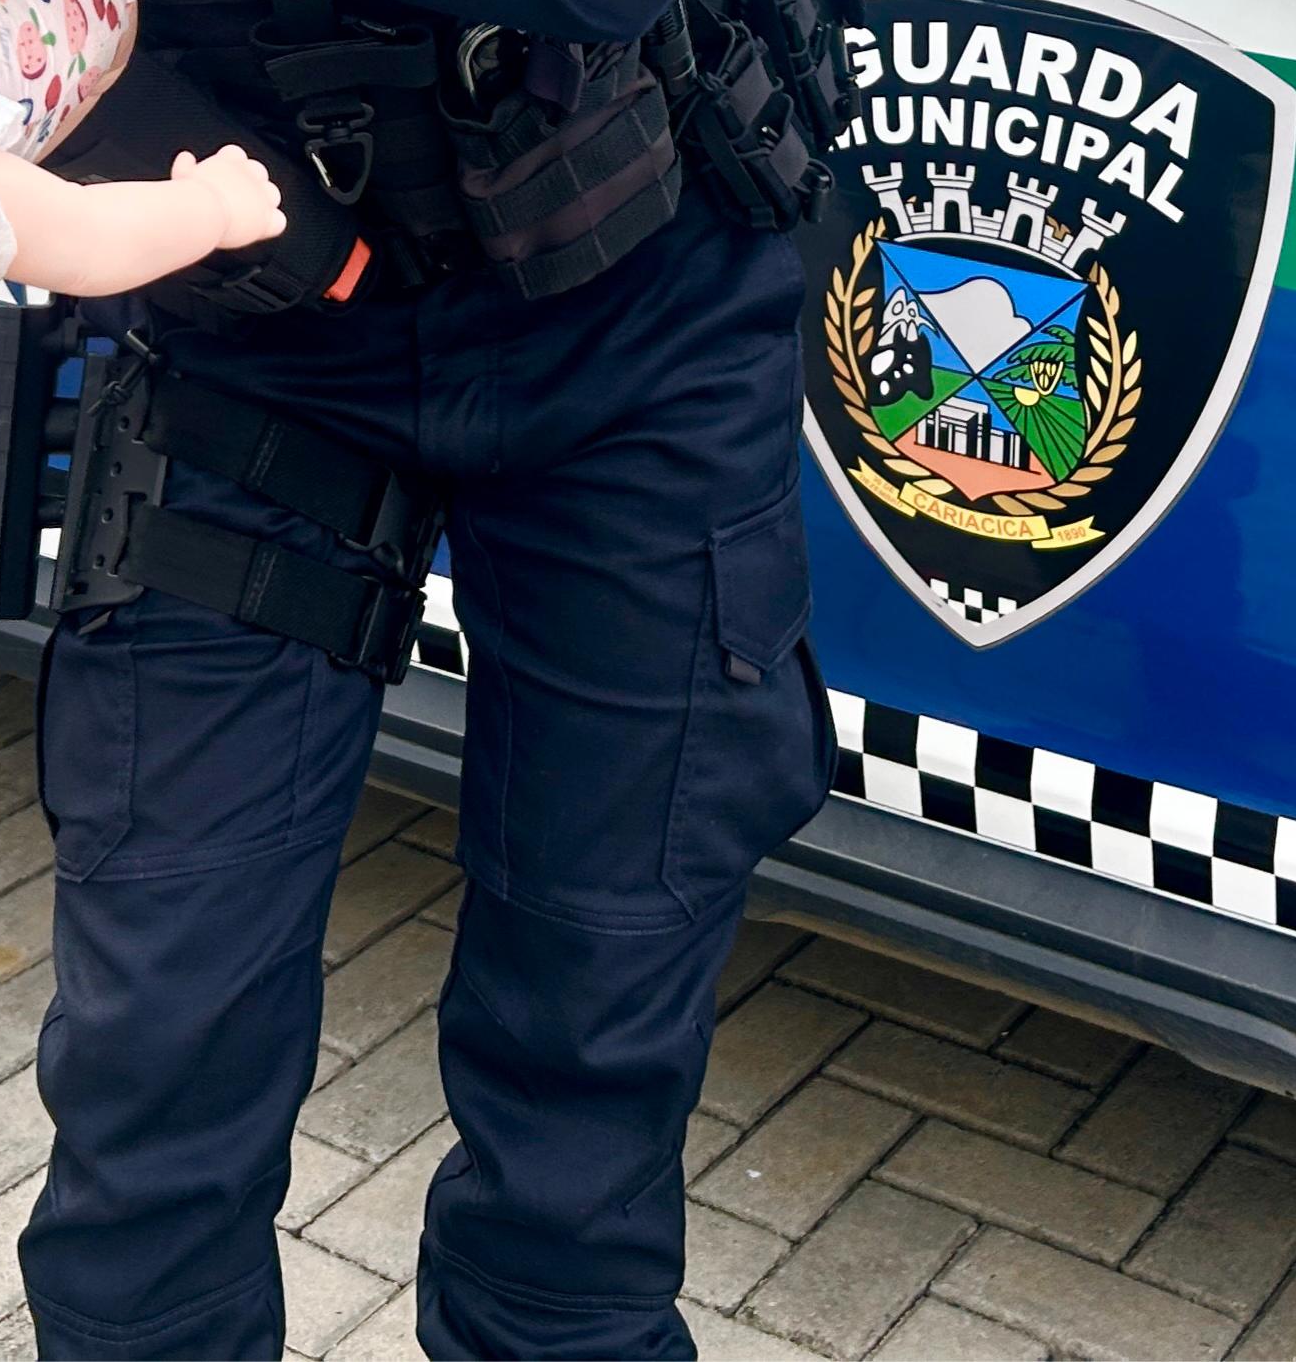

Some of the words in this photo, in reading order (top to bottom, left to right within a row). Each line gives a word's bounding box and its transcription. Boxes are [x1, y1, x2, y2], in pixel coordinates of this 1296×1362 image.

[843, 22, 1199, 159] GUARDA
[913, 492, 1034, 538] CARIACICA
[1056, 525, 1087, 543] 1890
